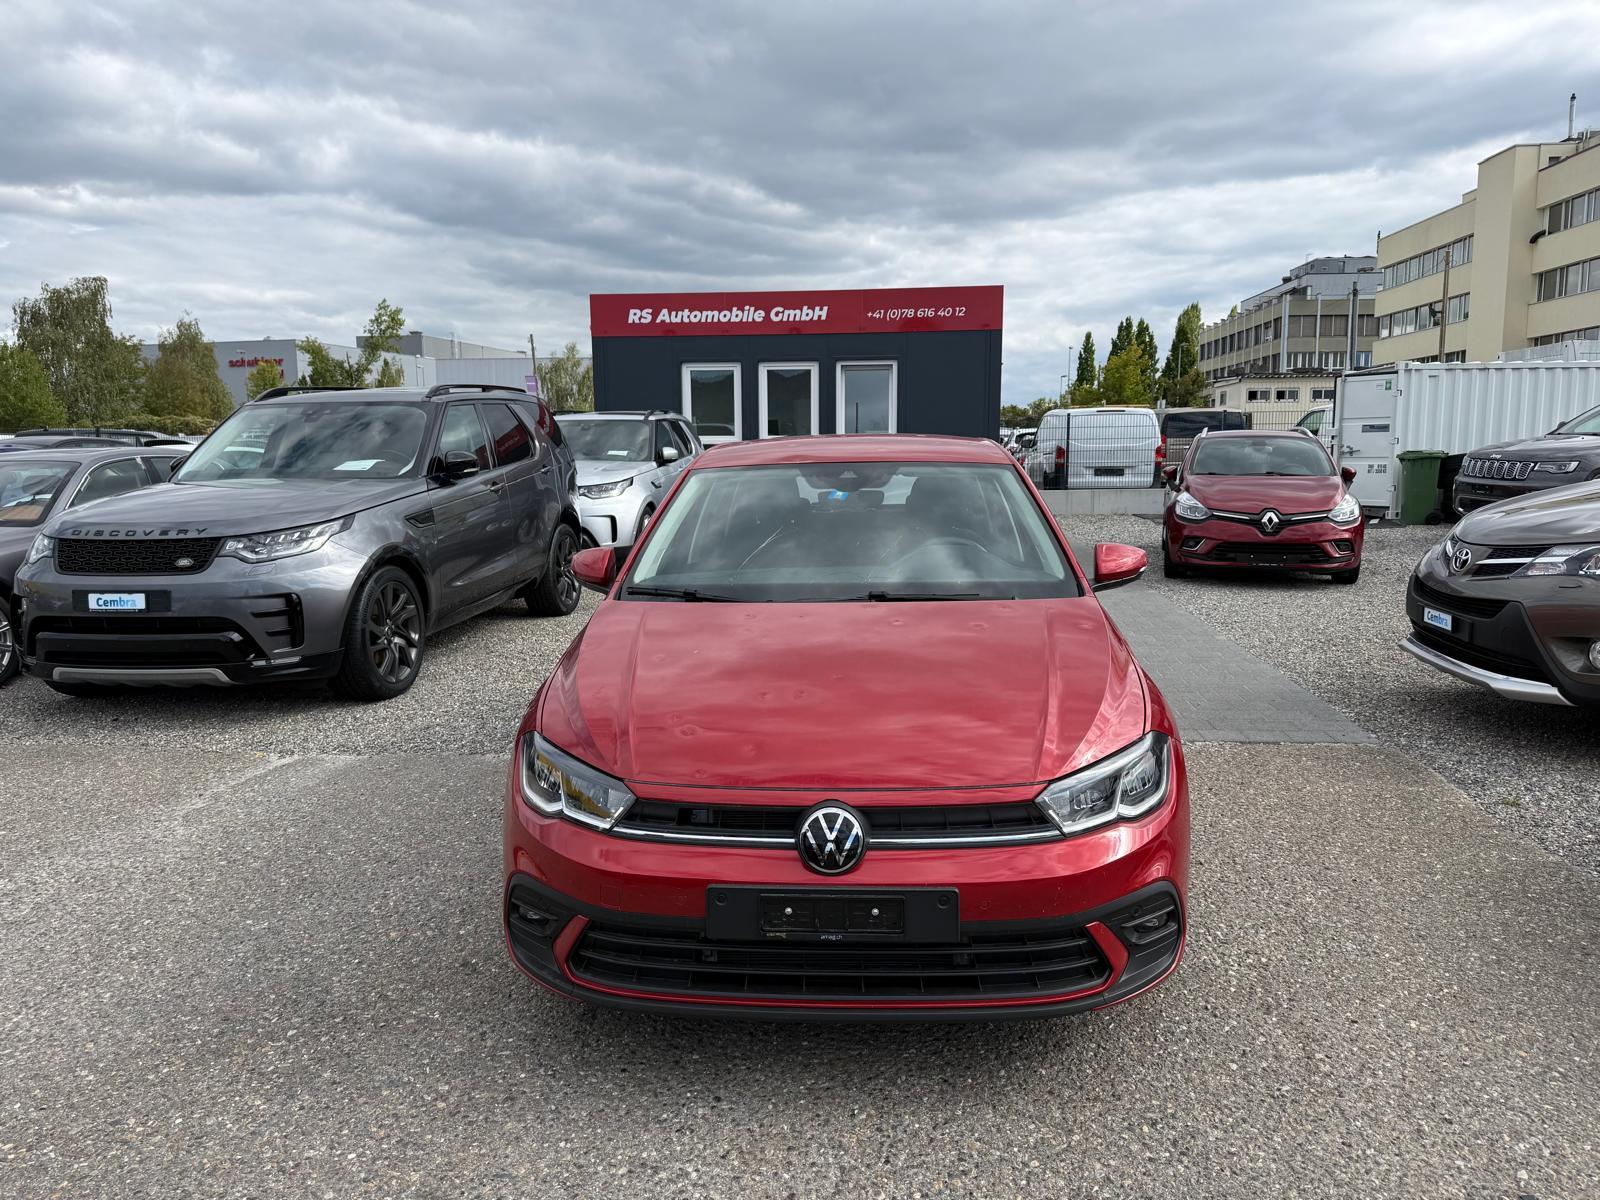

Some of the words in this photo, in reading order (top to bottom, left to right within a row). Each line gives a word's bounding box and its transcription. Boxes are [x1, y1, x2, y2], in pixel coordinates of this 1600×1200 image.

[628, 308, 652, 324] RS
[656, 305, 765, 323] Automobile
[770, 306, 828, 321] GmbH
[867, 309, 884, 319] +41
[886, 308, 915, 321] (0)78
[917, 308, 935, 318] 616
[937, 307, 952, 317] 40
[955, 307, 966, 316] 12
[71, 528, 208, 537] DISCOVERY
[96, 596, 137, 608] Cembra
[1427, 610, 1448, 627] Cembra
